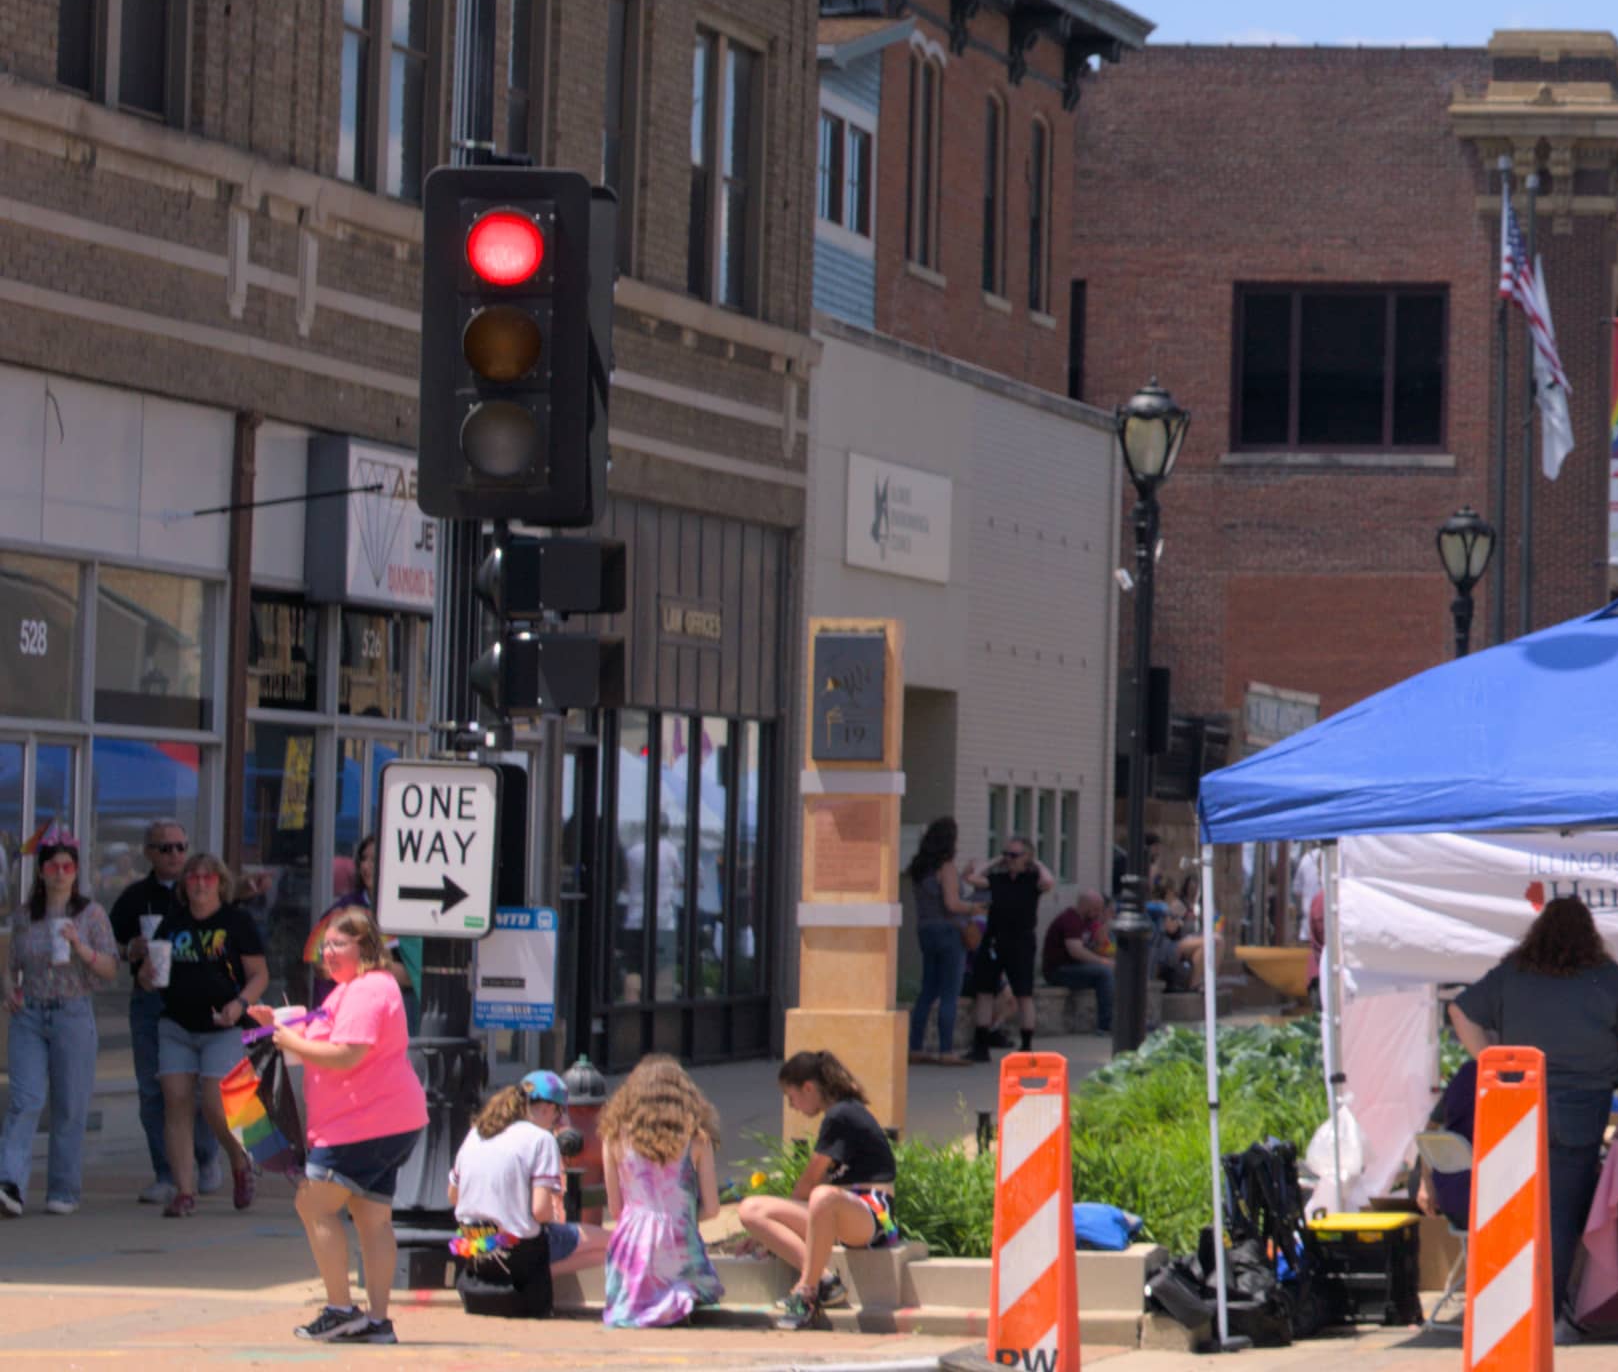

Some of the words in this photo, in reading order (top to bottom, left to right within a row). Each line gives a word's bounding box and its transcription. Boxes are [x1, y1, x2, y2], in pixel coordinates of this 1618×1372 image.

[20, 619, 48, 656] 528
[361, 629, 382, 659] 526
[401, 784, 477, 820] ONE
[397, 829, 477, 865] WAY
